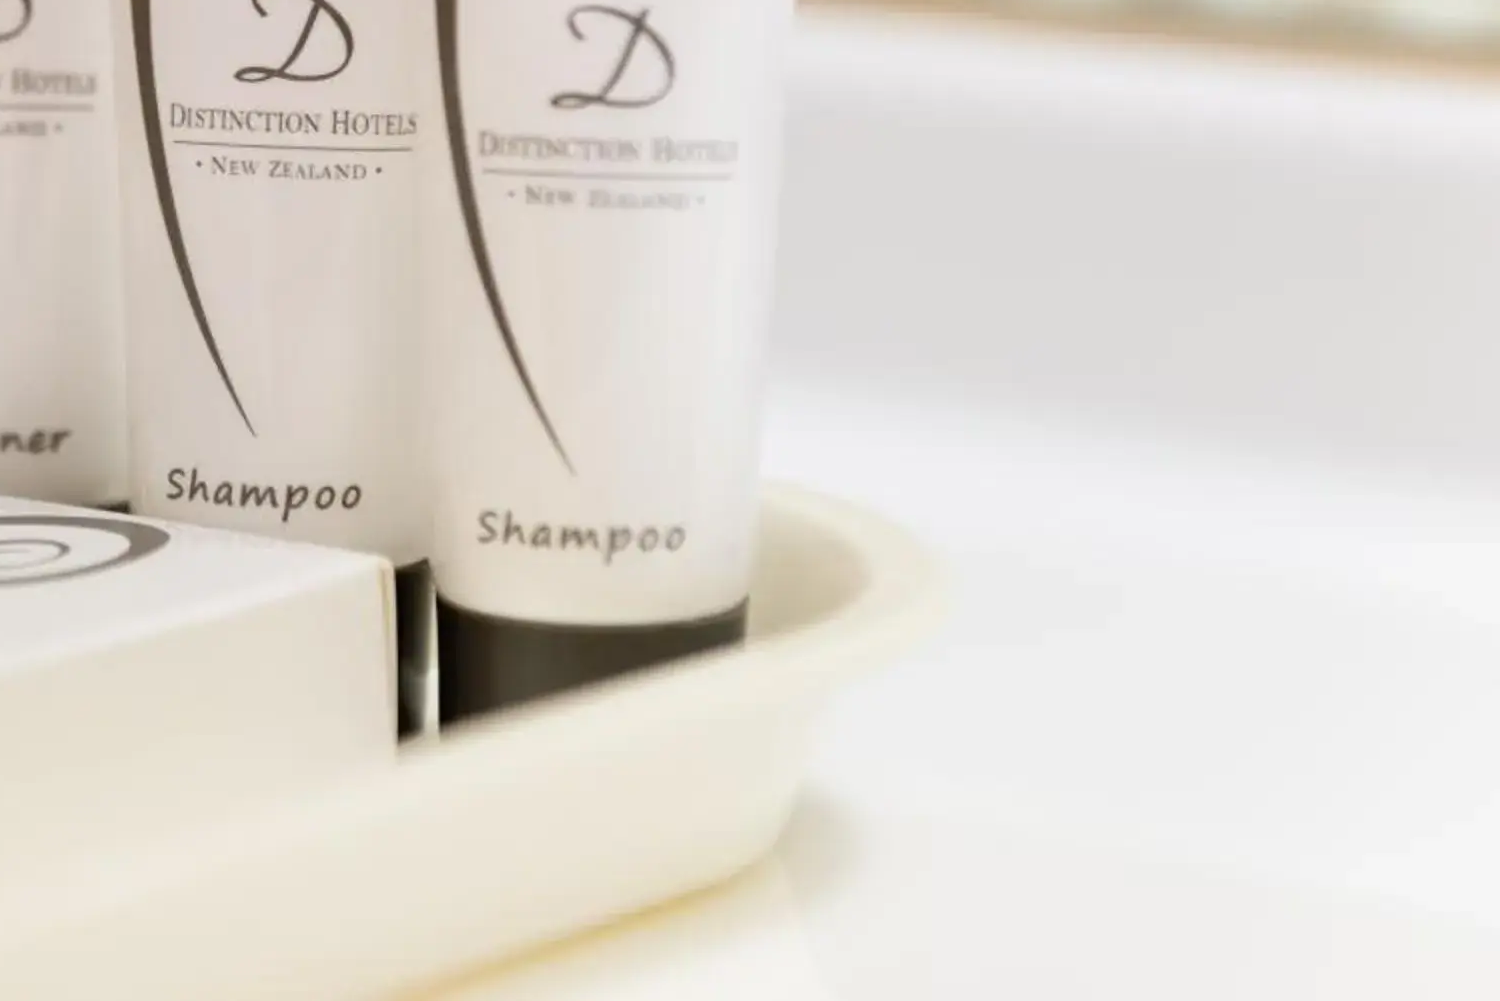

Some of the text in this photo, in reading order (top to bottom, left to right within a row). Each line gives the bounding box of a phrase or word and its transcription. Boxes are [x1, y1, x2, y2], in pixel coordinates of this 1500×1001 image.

[550, 4, 676, 109] D
[169, 102, 418, 137] DISTINCTION HOTELS
[211, 155, 367, 181] NEW ZEALAND
[166, 468, 363, 522] Shampoo
[475, 510, 687, 565] Shampoo
